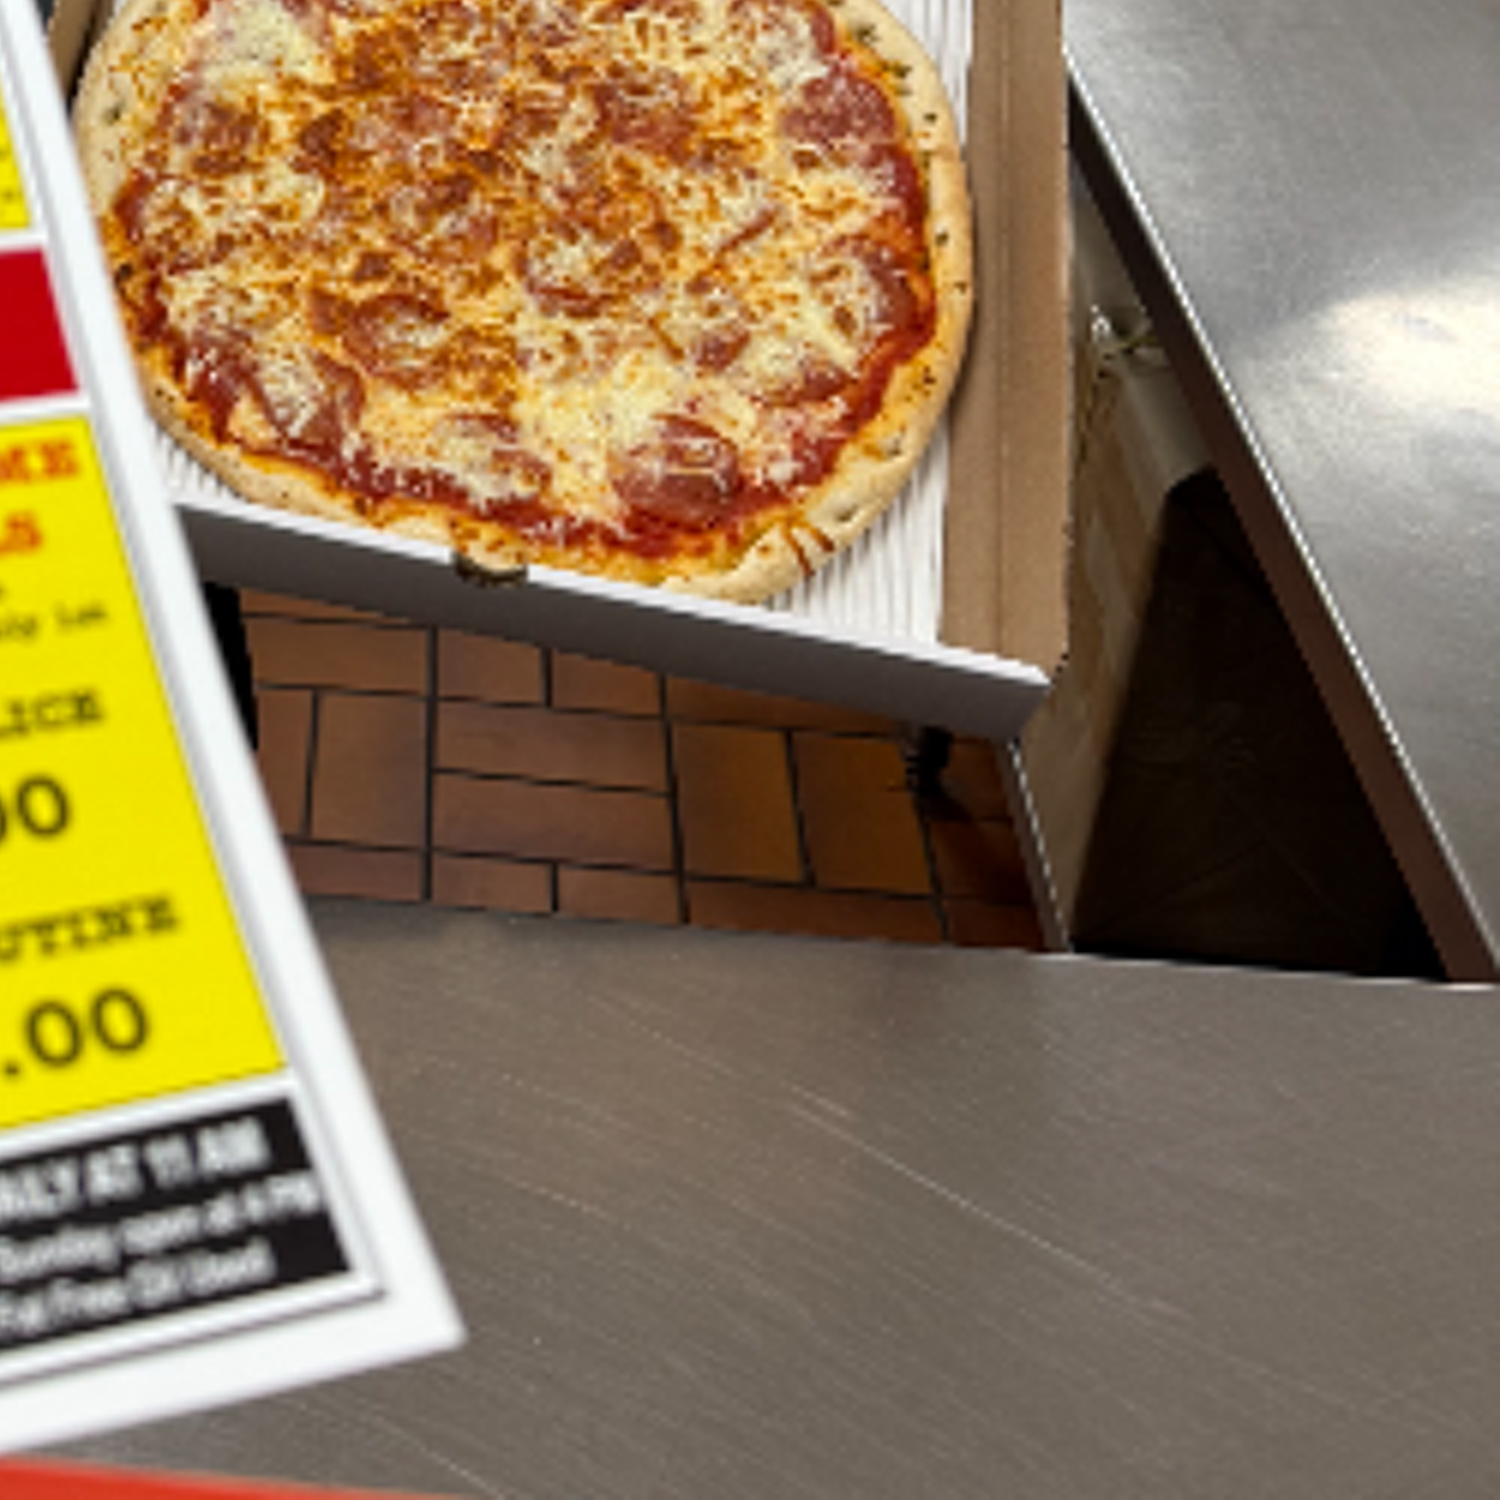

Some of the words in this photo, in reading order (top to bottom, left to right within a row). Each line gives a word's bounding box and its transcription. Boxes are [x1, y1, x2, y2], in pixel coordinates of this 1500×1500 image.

[83, 1140, 144, 1204] AT
[198, 1115, 273, 1180] AM
[119, 1204, 201, 1256] open
[47, 1277, 129, 1320] Free
[185, 1236, 277, 1300] Used
